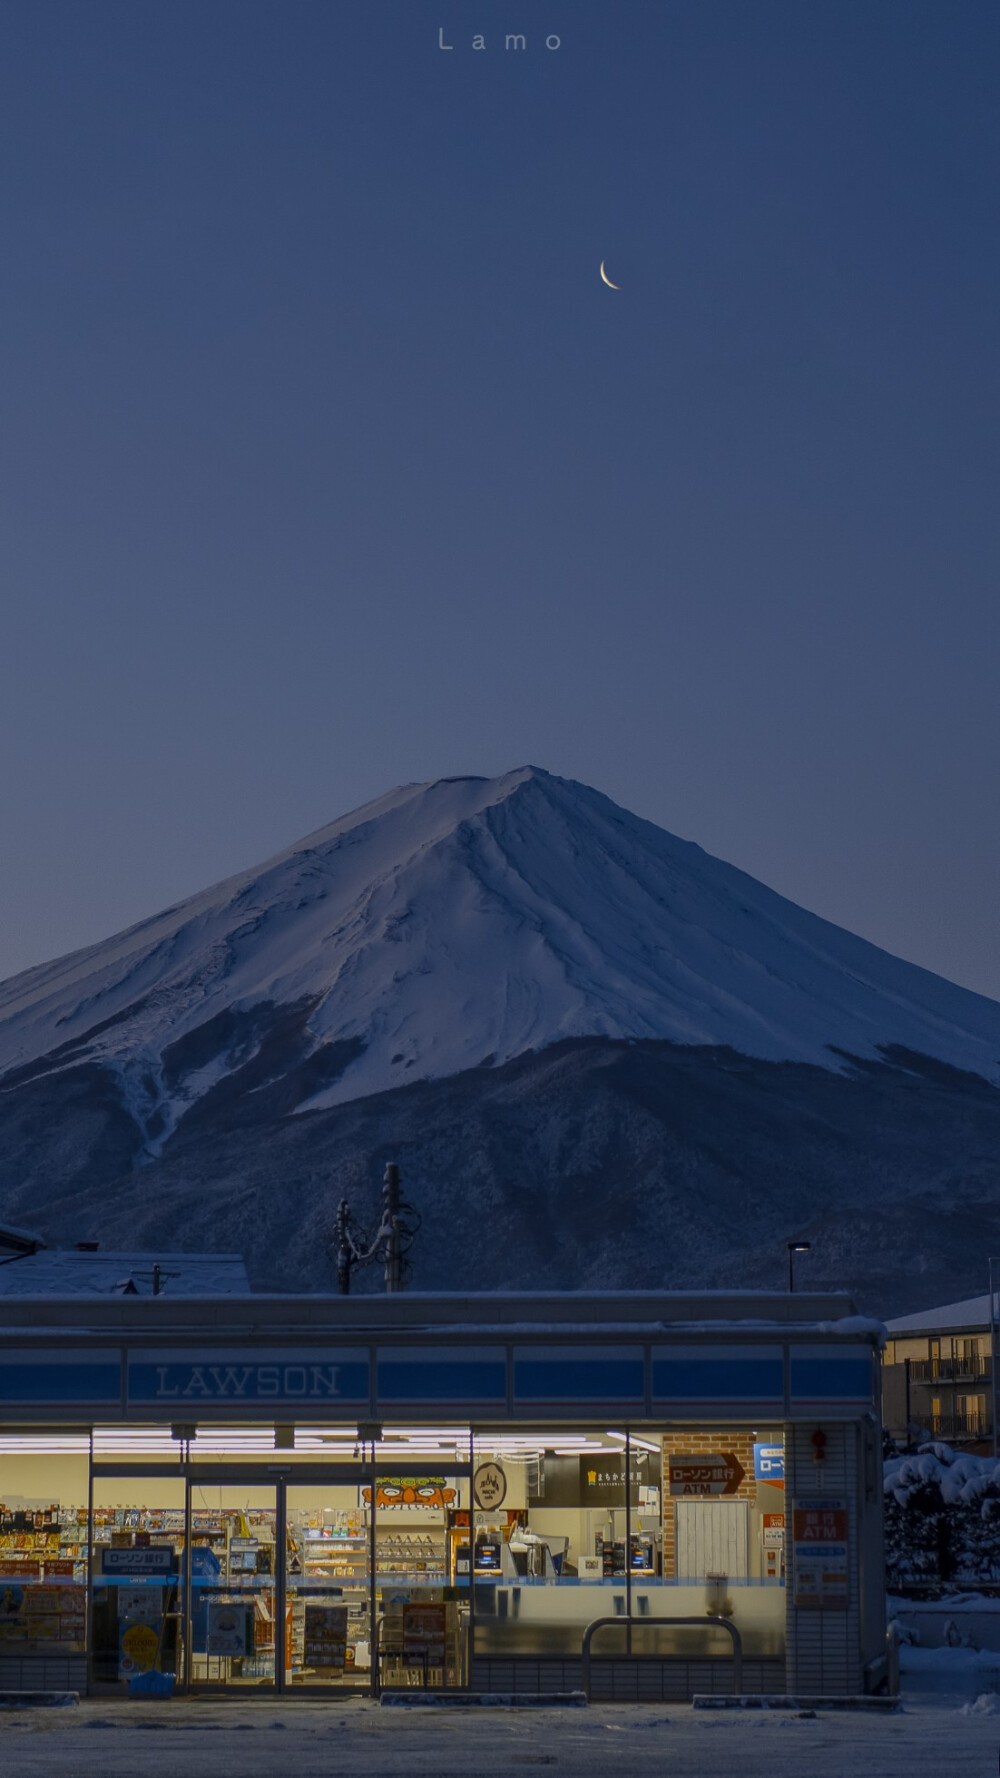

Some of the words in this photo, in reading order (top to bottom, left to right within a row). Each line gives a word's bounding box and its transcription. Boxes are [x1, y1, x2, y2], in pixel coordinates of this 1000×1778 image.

[156, 1366, 341, 1396] LAWSON
[672, 1468, 735, 1480] ローソン銀行
[683, 1484, 711, 1494] ATM
[806, 1512, 835, 1525] 銀行
[803, 1526, 837, 1538] ATM
[110, 1553, 164, 1563] ローソン銀行
